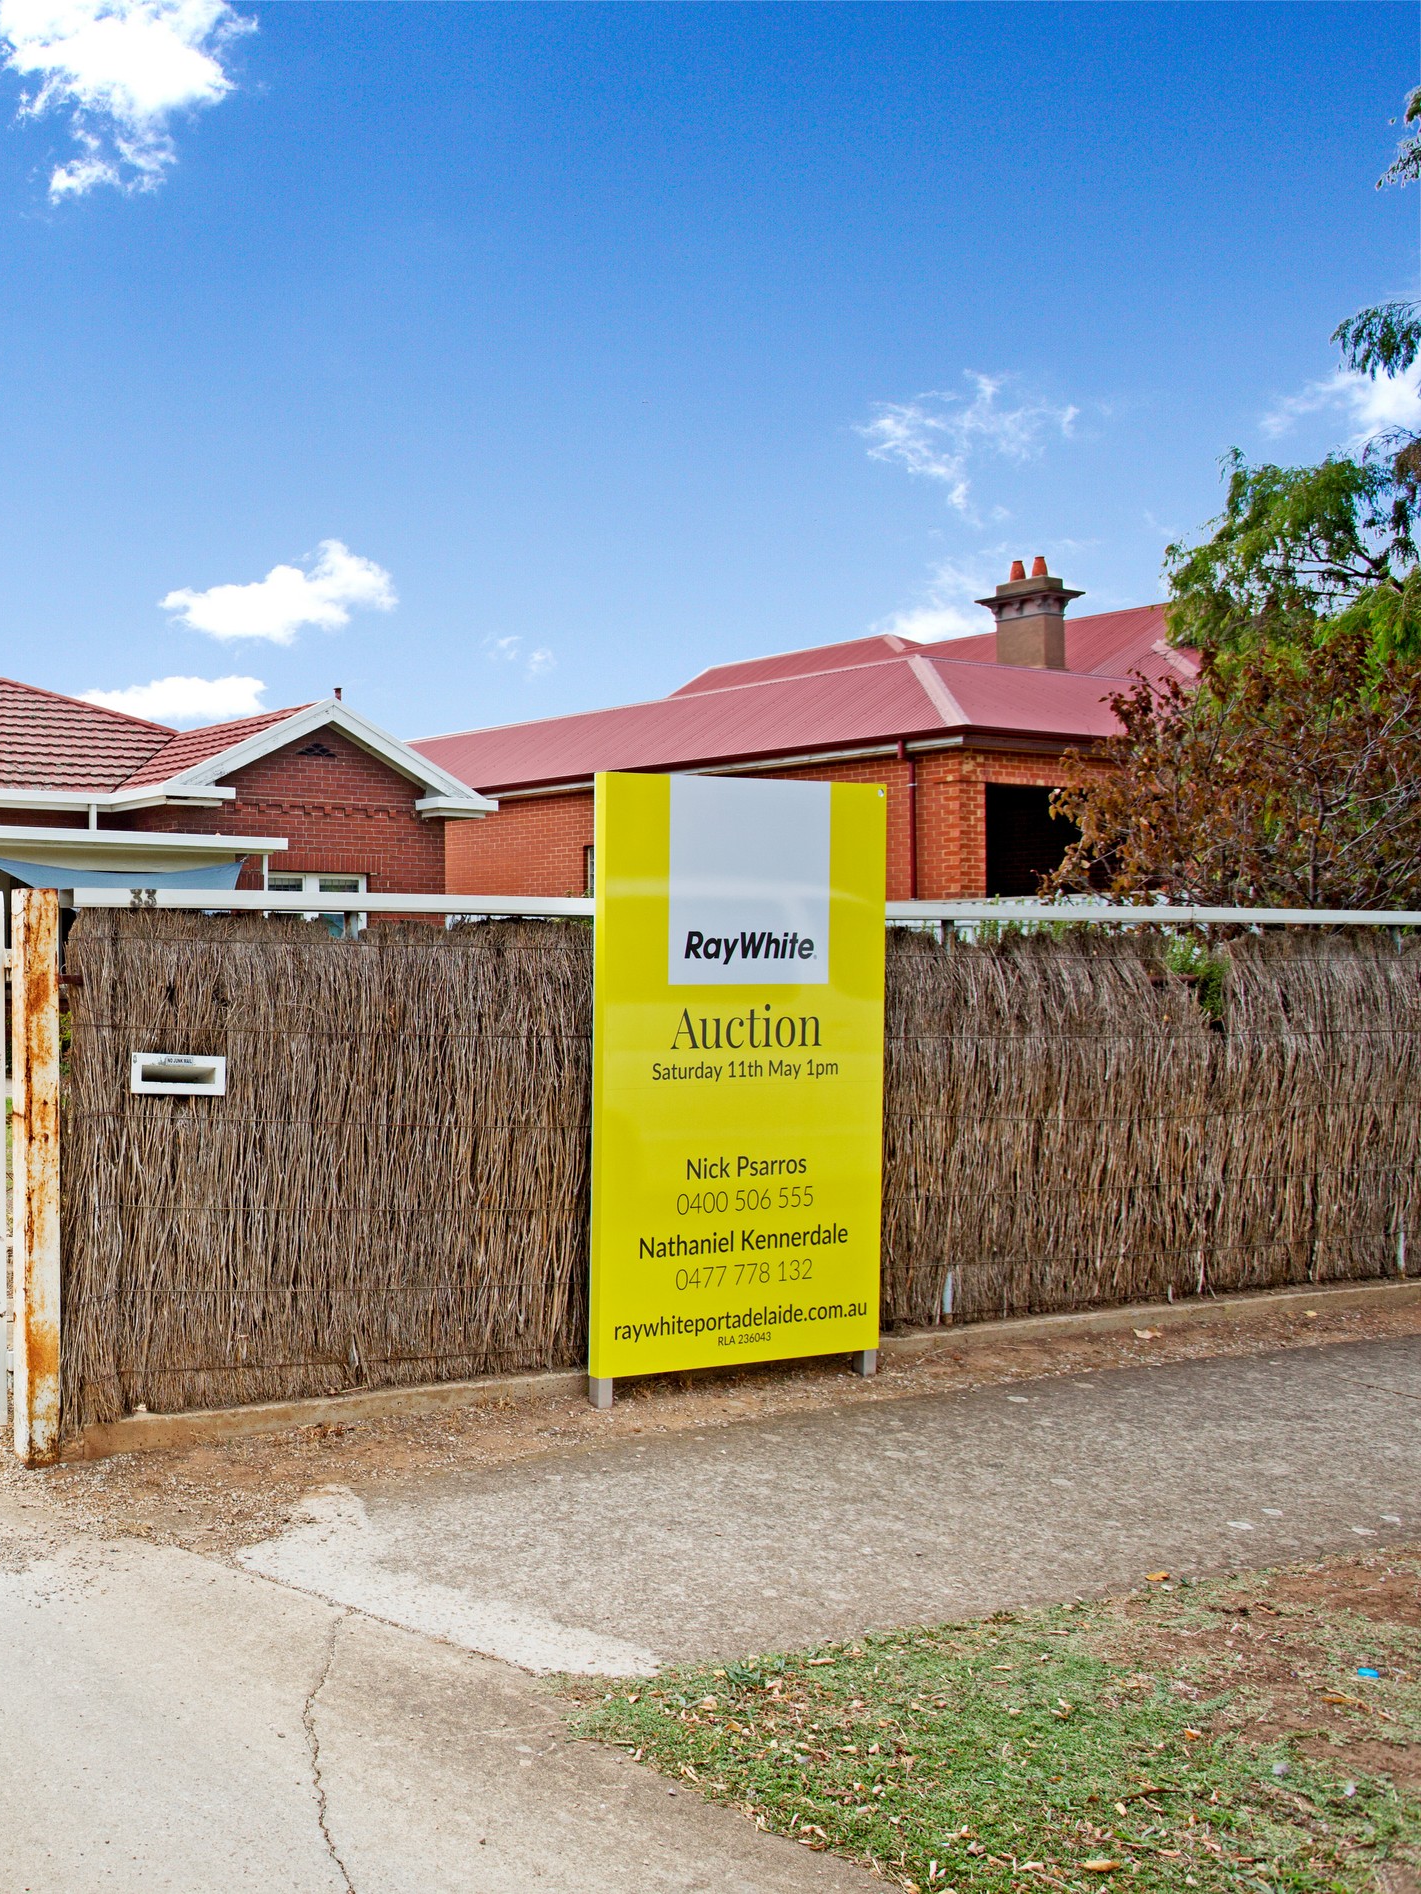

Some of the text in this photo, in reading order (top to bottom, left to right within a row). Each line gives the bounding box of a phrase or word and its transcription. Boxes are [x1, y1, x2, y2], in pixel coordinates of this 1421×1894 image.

[129, 888, 157, 908] 33
[671, 1004, 822, 1049] Auction
[652, 1059, 838, 1081] Saturday 11th May 1pm
[687, 1156, 806, 1180] Nick Psarros
[677, 1186, 813, 1215] 0400 506 555
[640, 1223, 848, 1259] Nathaniel Kennerdale
[676, 1259, 813, 1290] 0477 778 132
[614, 1301, 867, 1342] raywhiteportadelaide.com.au
[718, 1332, 771, 1346] RLA 236043
